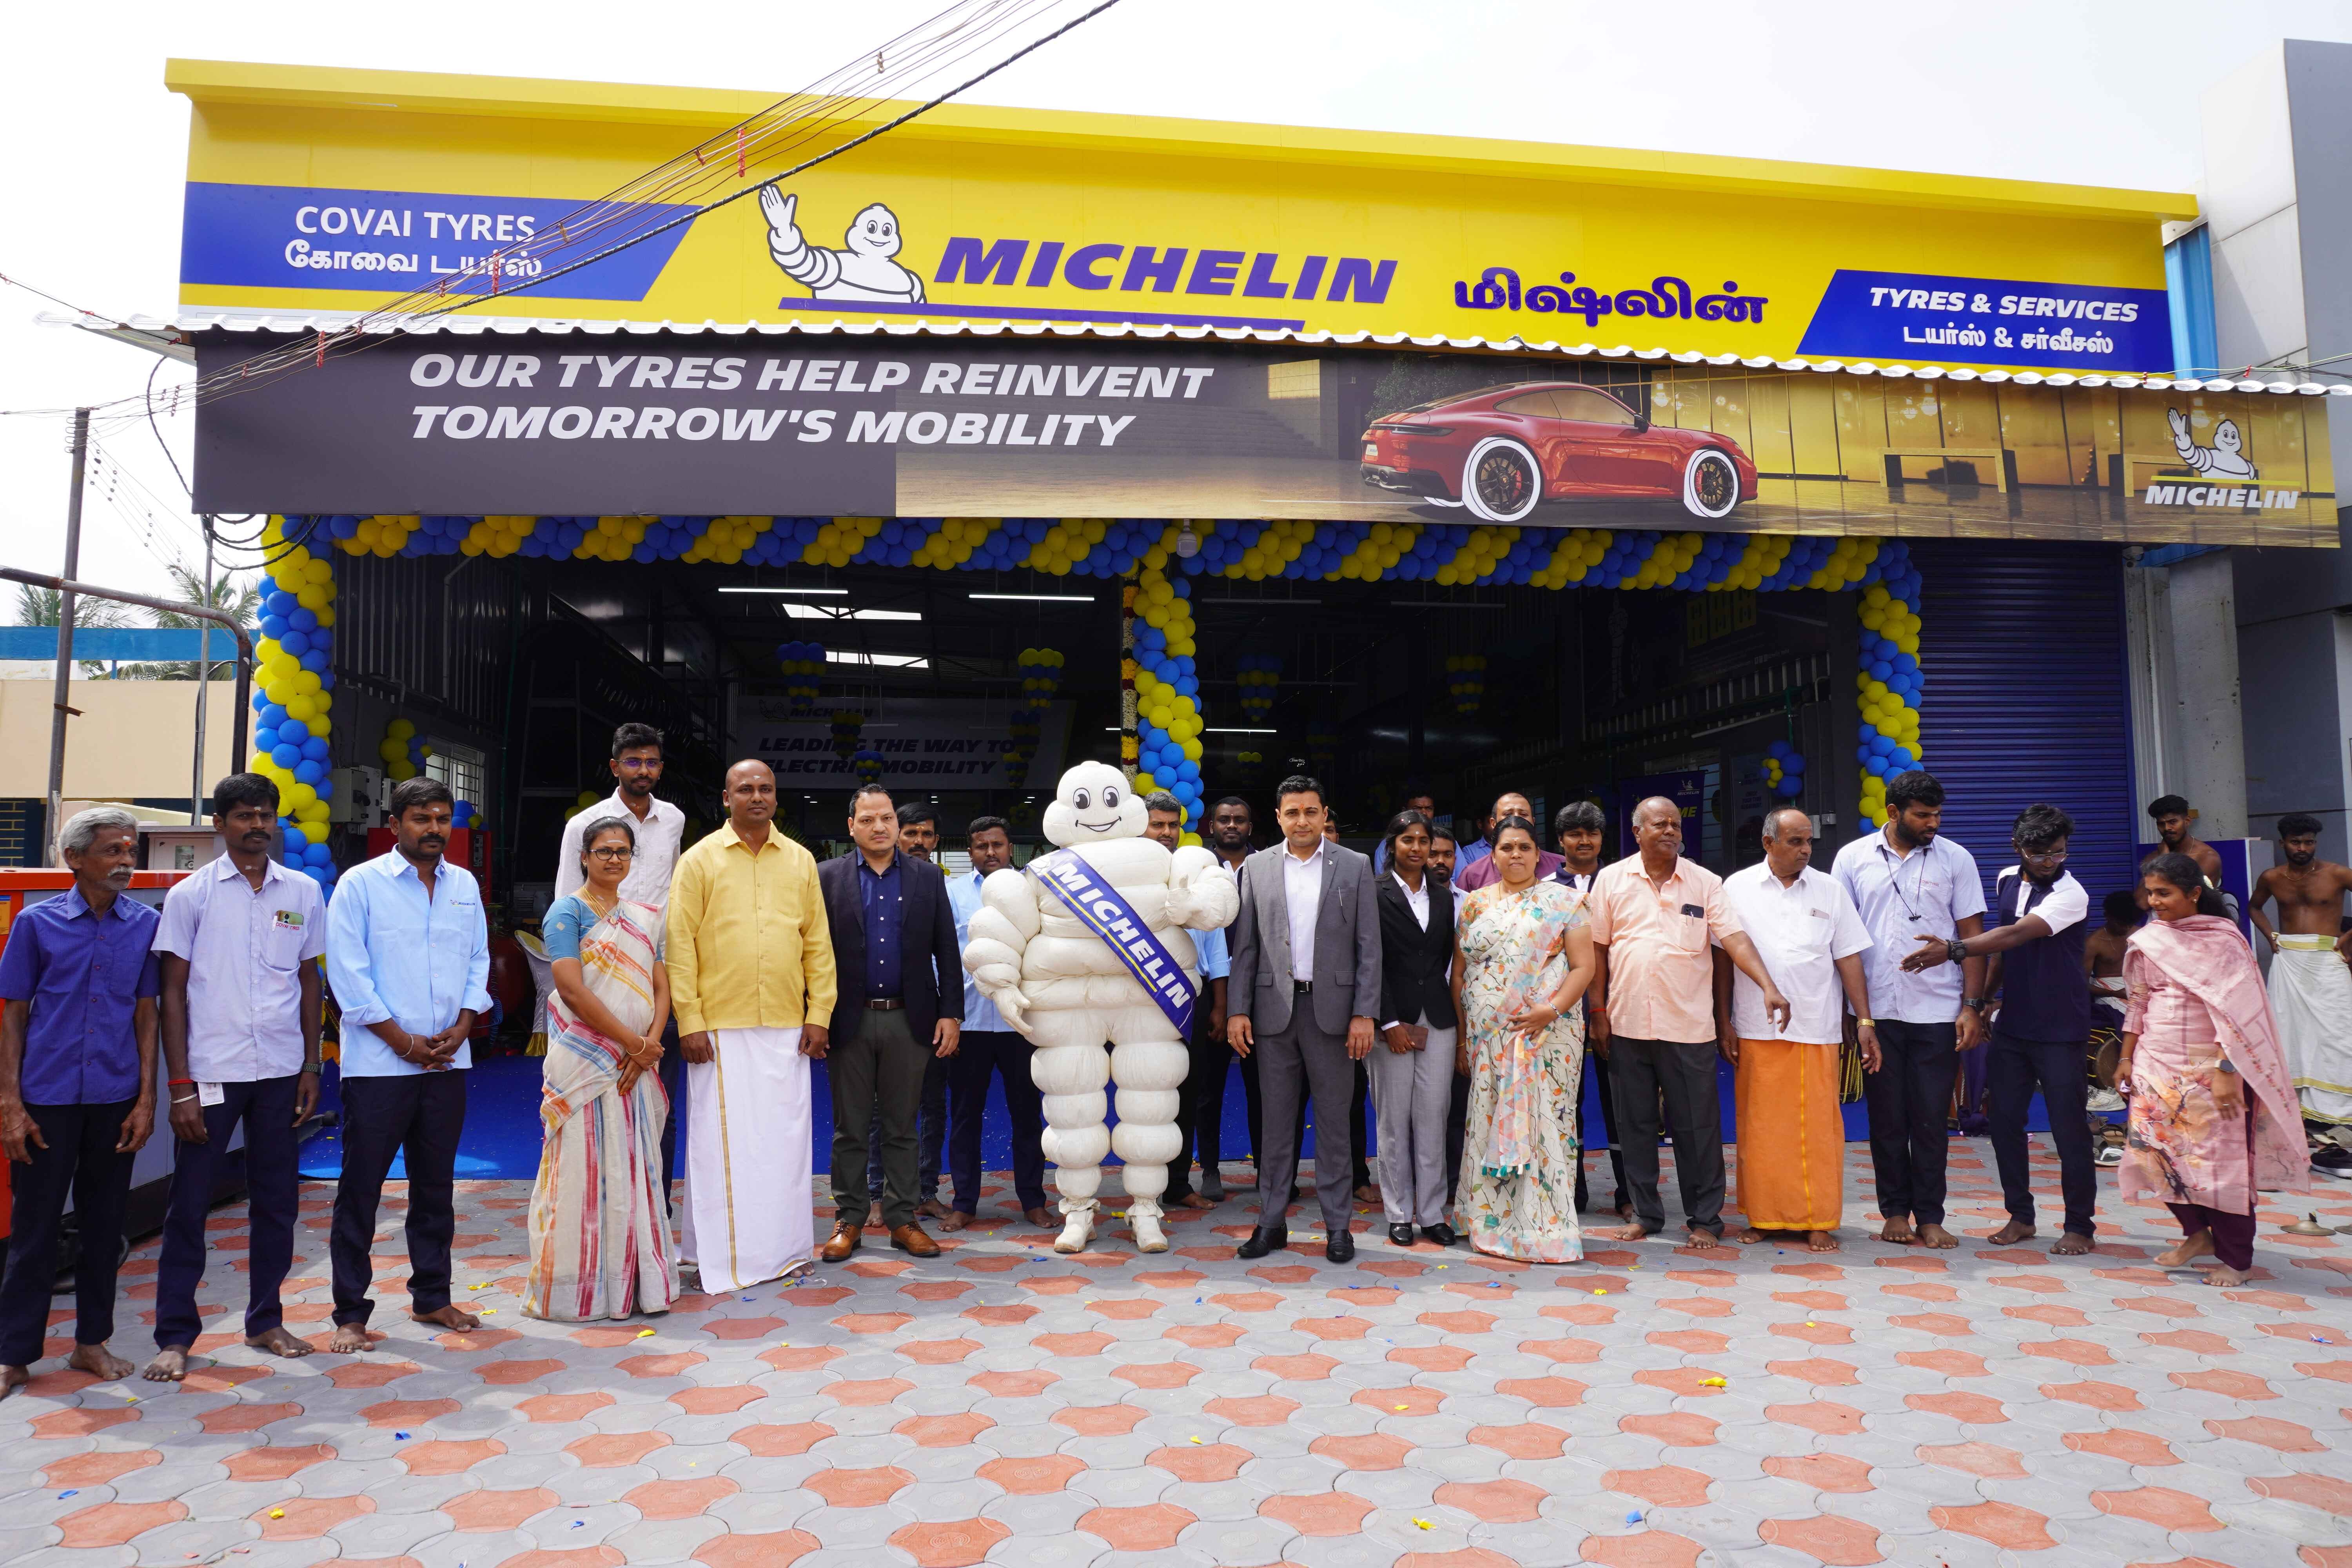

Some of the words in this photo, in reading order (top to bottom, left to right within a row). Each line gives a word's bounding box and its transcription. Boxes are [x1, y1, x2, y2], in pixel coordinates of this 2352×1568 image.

[295, 206, 411, 237] COVAI
[424, 212, 535, 242] TYRES
[285, 239, 418, 272] கோவை
[430, 249, 542, 277] டயர்ஸ்
[934, 236, 1398, 304] MICHELIN
[1454, 267, 1768, 327] மிஷ்லின்
[1870, 287, 1966, 312] TYRES
[1971, 294, 1991, 313] &
[2000, 295, 2139, 322] SERVICES
[1904, 322, 1986, 347] டயர்ஸ்
[1994, 327, 2014, 348] &
[2021, 327, 2114, 354] சர்வீசஸ்
[410, 354, 541, 387] OUR
[558, 355, 747, 390] TYRES
[756, 358, 911, 393] HELP
[920, 362, 1214, 399] REINVENT
[412, 405, 837, 443] TOMORROW'S
[846, 410, 1137, 446] MOBILITY
[2145, 485, 2299, 509] MICHELIN
[758, 737, 867, 751] LEADIG
[874, 739, 919, 752] THE
[924, 739, 983, 752] WAY
[987, 740, 1015, 753] TO
[763, 759, 857, 773] ELECTRI
[882, 760, 998, 774] MOBILITY
[1051, 862, 1191, 1009] MICHELIN
